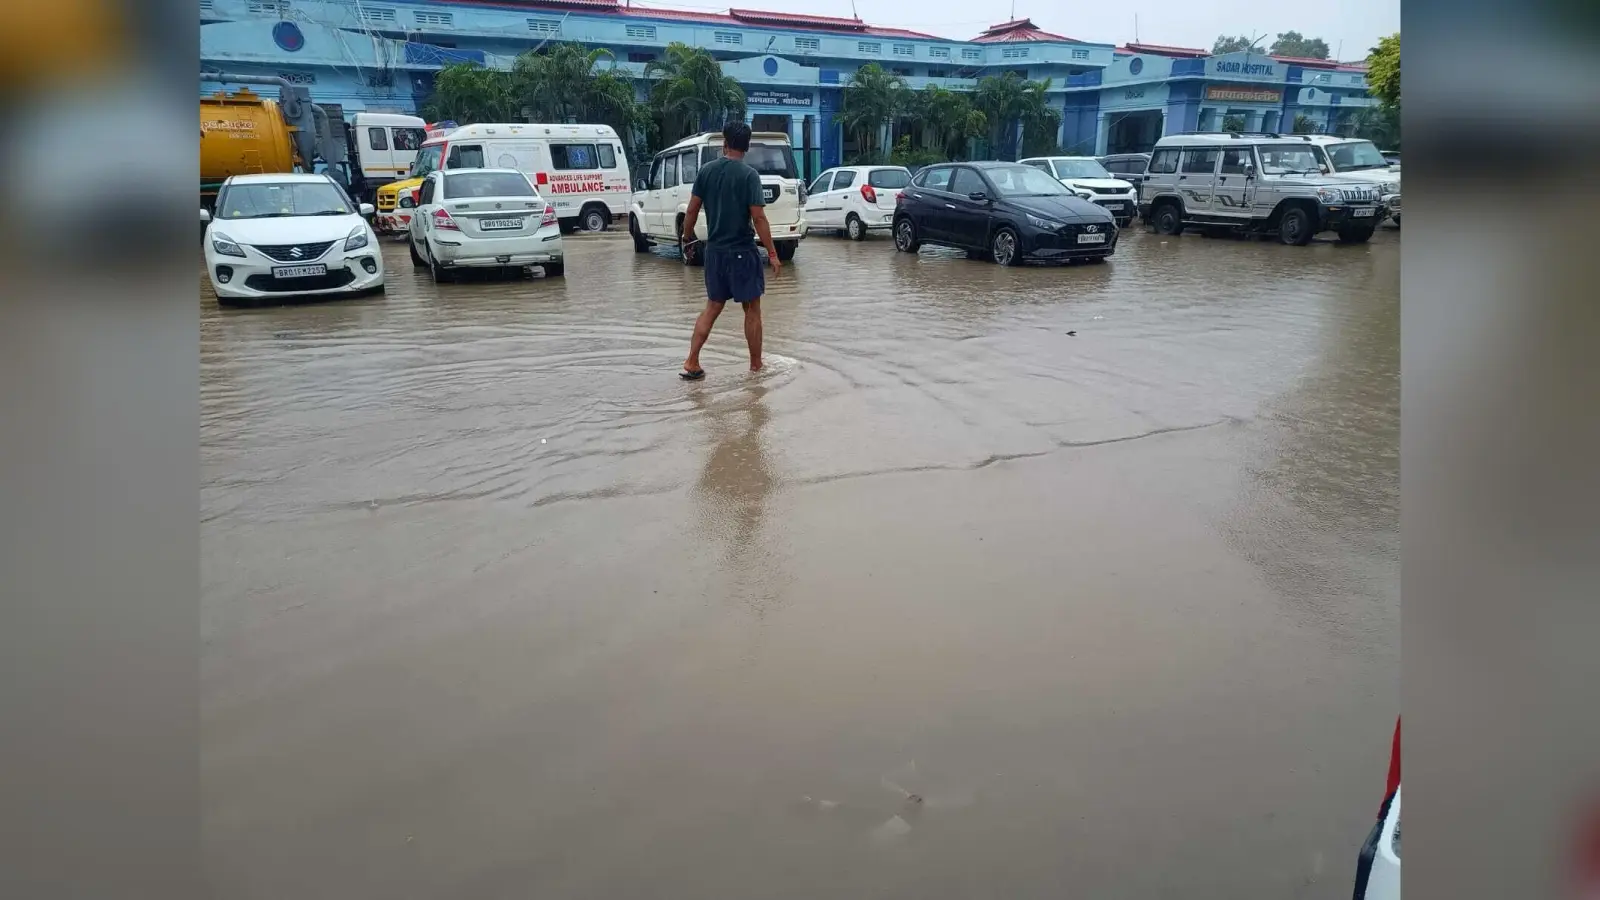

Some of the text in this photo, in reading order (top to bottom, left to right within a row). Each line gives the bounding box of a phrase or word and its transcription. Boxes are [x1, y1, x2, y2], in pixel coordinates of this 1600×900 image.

[1216, 61, 1274, 76] SADAR HOSPITAL
[583, 173, 603, 181] SUPPORT
[551, 182, 605, 194] AMBULANCE
